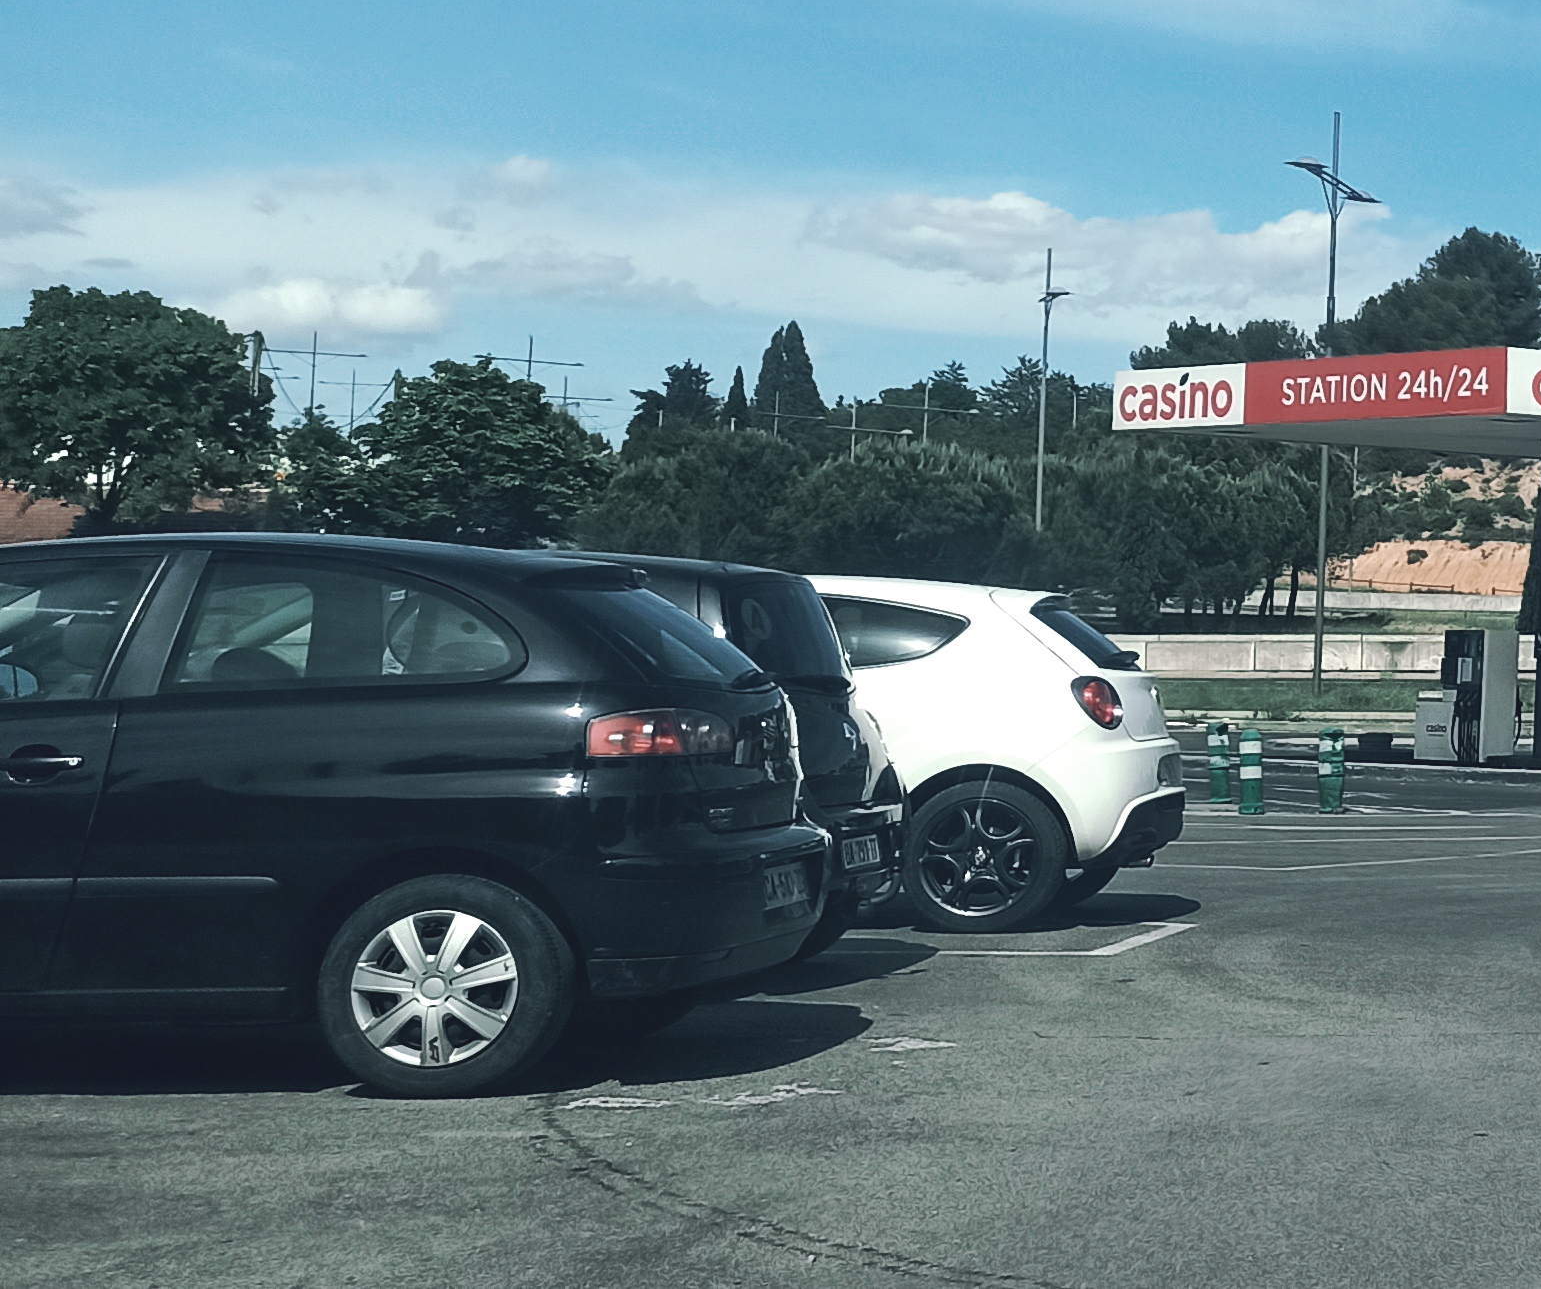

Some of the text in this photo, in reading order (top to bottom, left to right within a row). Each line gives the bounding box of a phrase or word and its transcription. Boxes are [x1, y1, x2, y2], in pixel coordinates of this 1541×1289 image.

[1119, 372, 1233, 422] casino
[1281, 364, 1489, 406] STATION 24h/24
